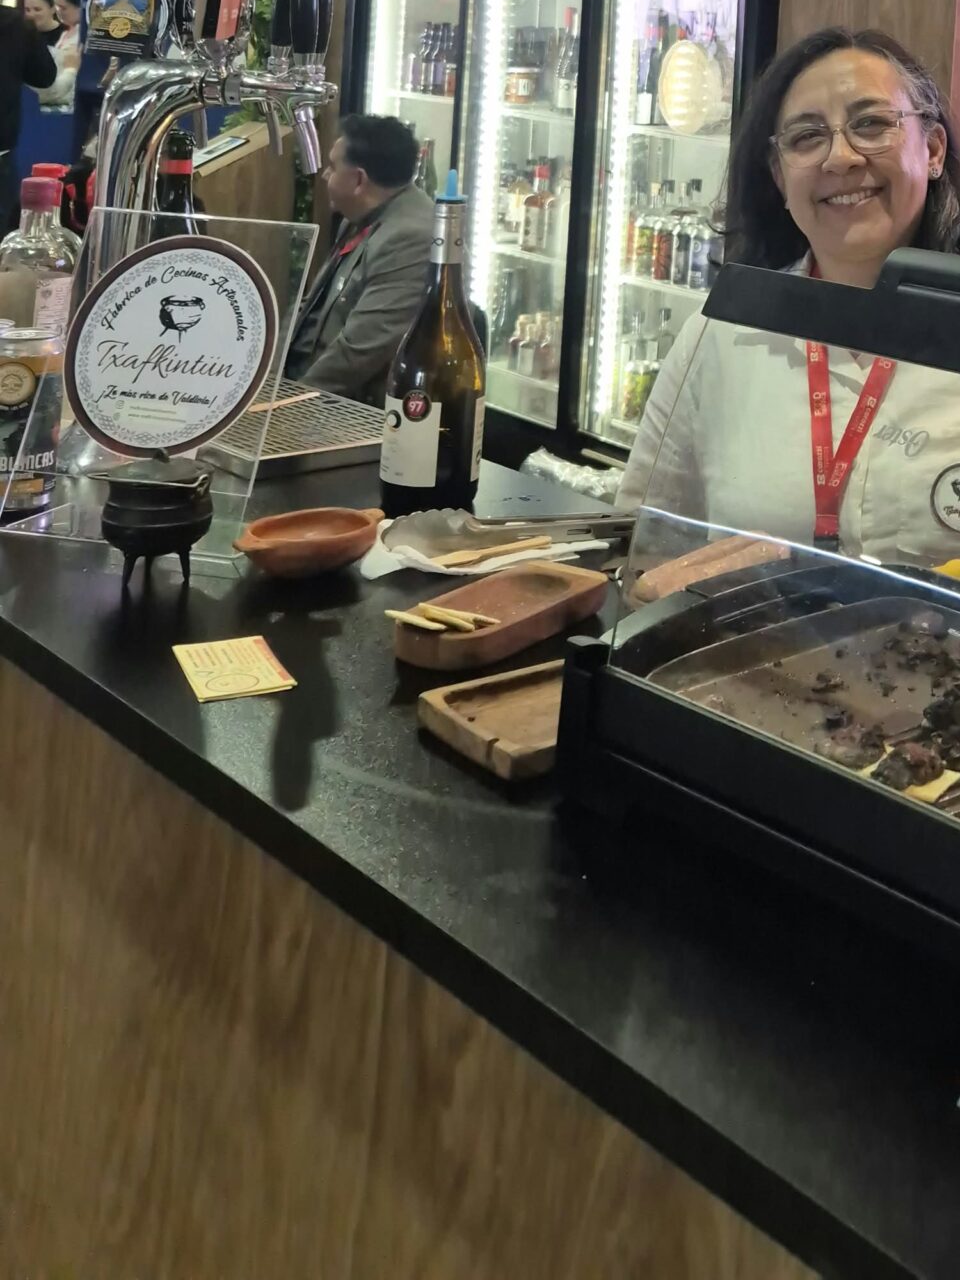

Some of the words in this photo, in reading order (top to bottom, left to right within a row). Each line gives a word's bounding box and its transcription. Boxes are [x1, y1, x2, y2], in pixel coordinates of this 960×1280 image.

[144, 274, 158, 288] de
[160, 265, 209, 284] Cecinas
[209, 276, 248, 342] Artesanales
[96, 339, 235, 384] Txafkintün
[408, 401, 423, 413] 97
[873, 424, 931, 458] Oster
